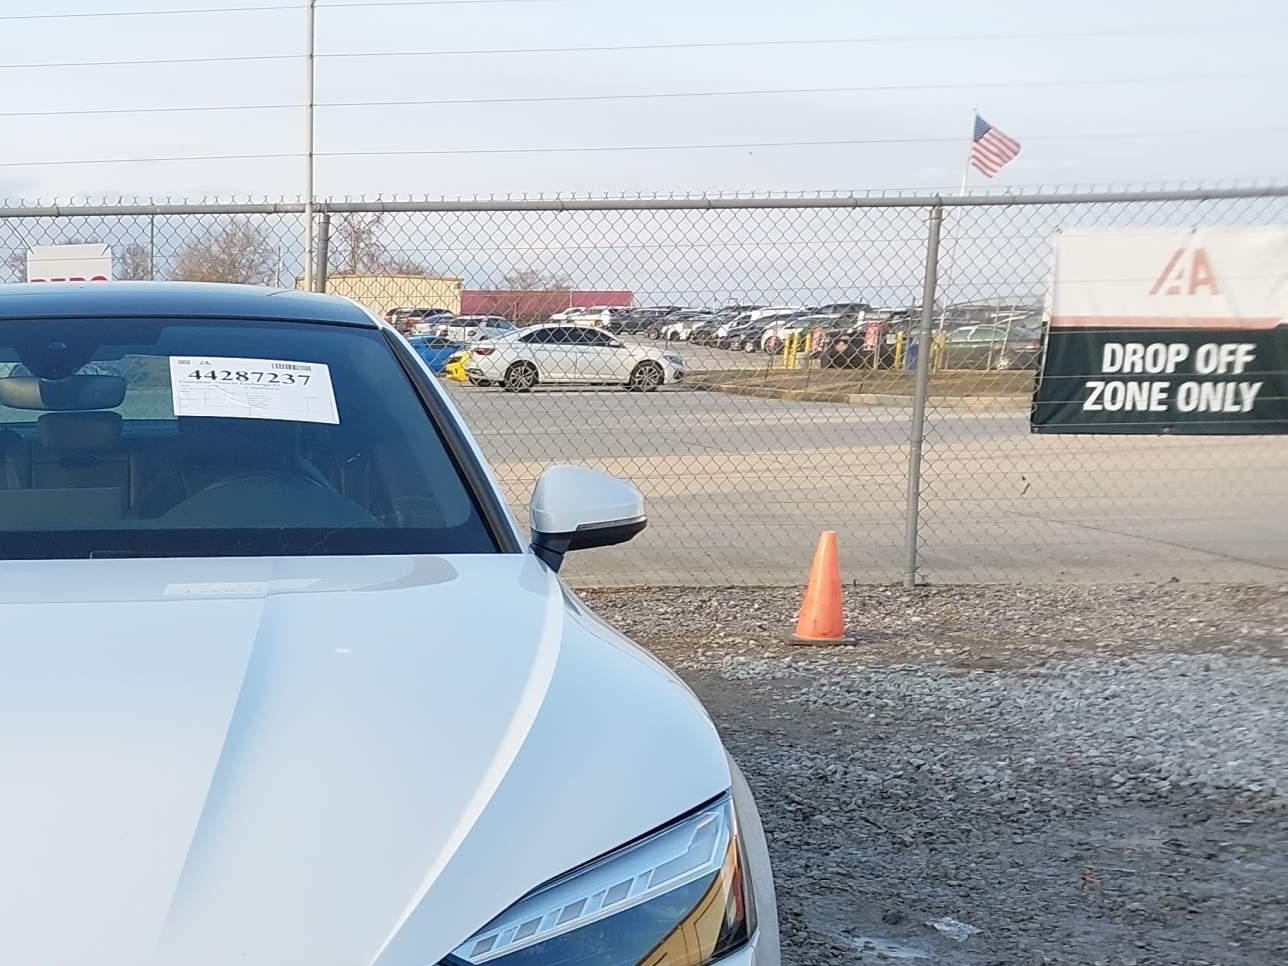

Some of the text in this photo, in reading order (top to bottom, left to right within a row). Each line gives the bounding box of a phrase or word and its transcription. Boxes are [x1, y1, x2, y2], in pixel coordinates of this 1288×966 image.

[1102, 343, 1256, 375] DROP OFF
[188, 369, 311, 387] 44287237
[1082, 381, 1264, 413] ZONE ONLY
